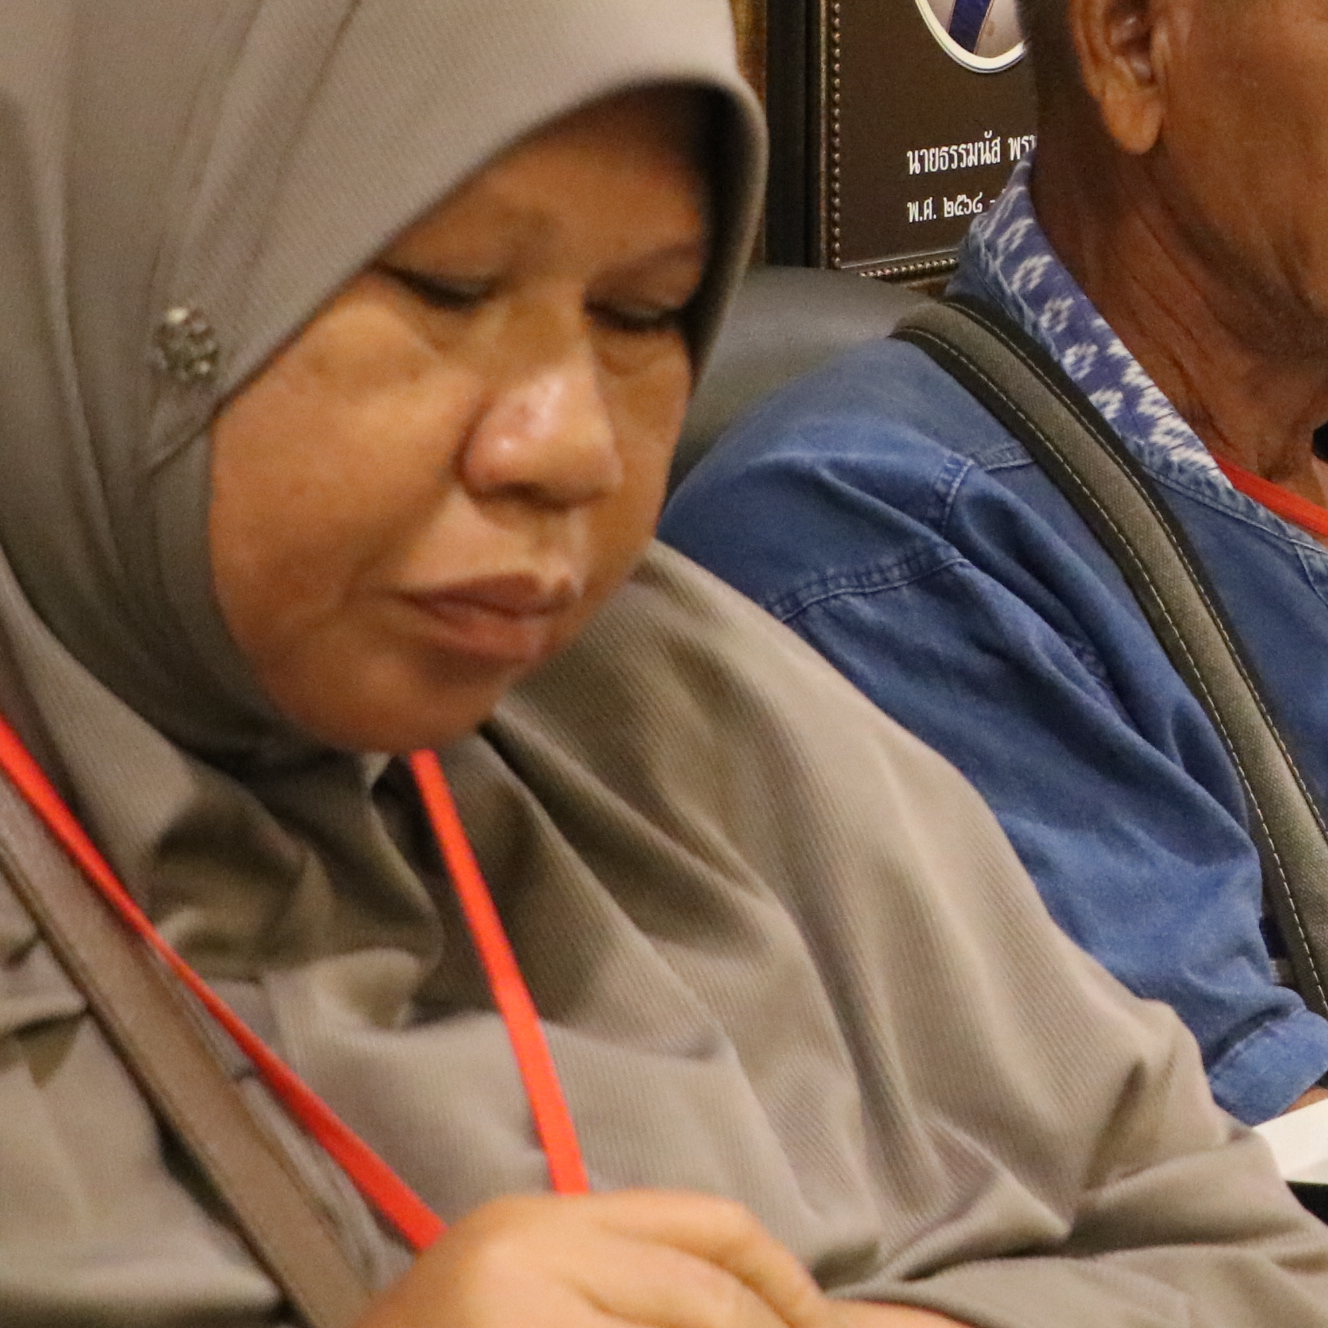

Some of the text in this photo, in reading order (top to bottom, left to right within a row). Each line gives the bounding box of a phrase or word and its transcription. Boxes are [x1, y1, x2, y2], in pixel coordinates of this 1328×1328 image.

[907, 130, 1001, 174] นายธรรมนัส
[907, 197, 936, 222] พ.ศ.
